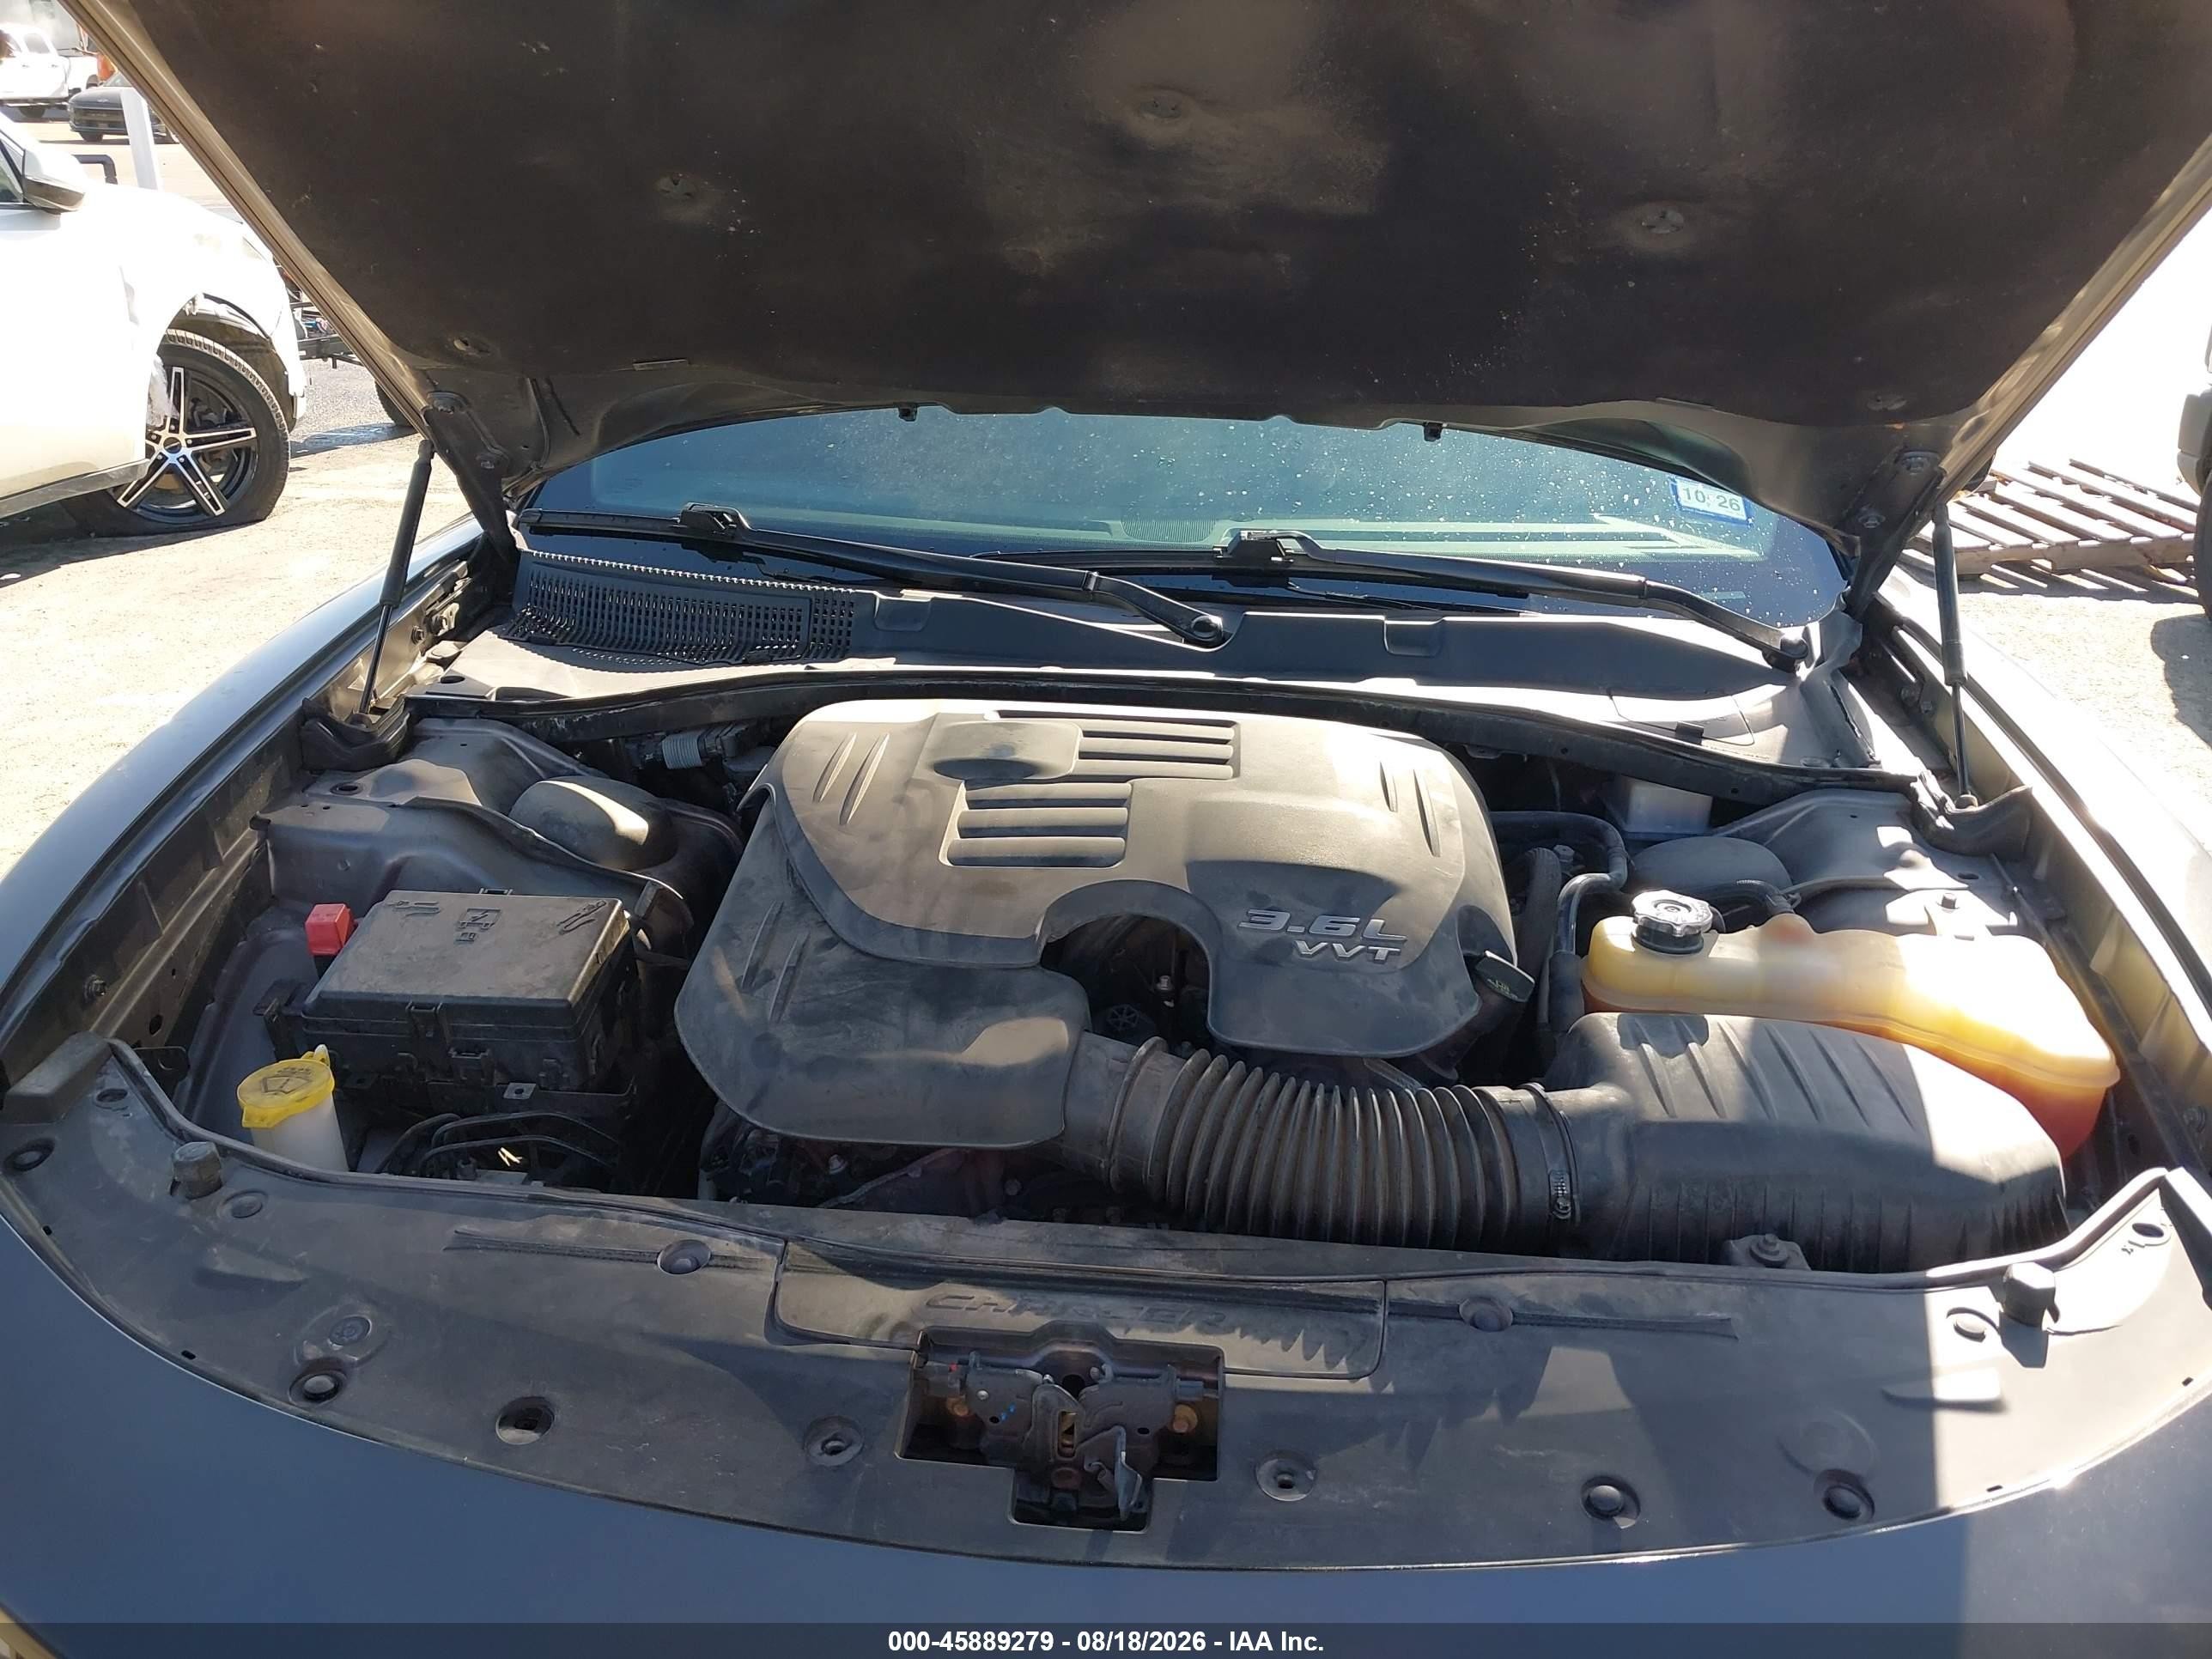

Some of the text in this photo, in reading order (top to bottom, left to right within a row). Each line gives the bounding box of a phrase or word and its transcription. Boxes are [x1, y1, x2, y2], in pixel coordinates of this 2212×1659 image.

[1716, 495, 1741, 512] 26
[1238, 908, 1408, 941] 3.6L
[1294, 939, 1401, 963] VVT
